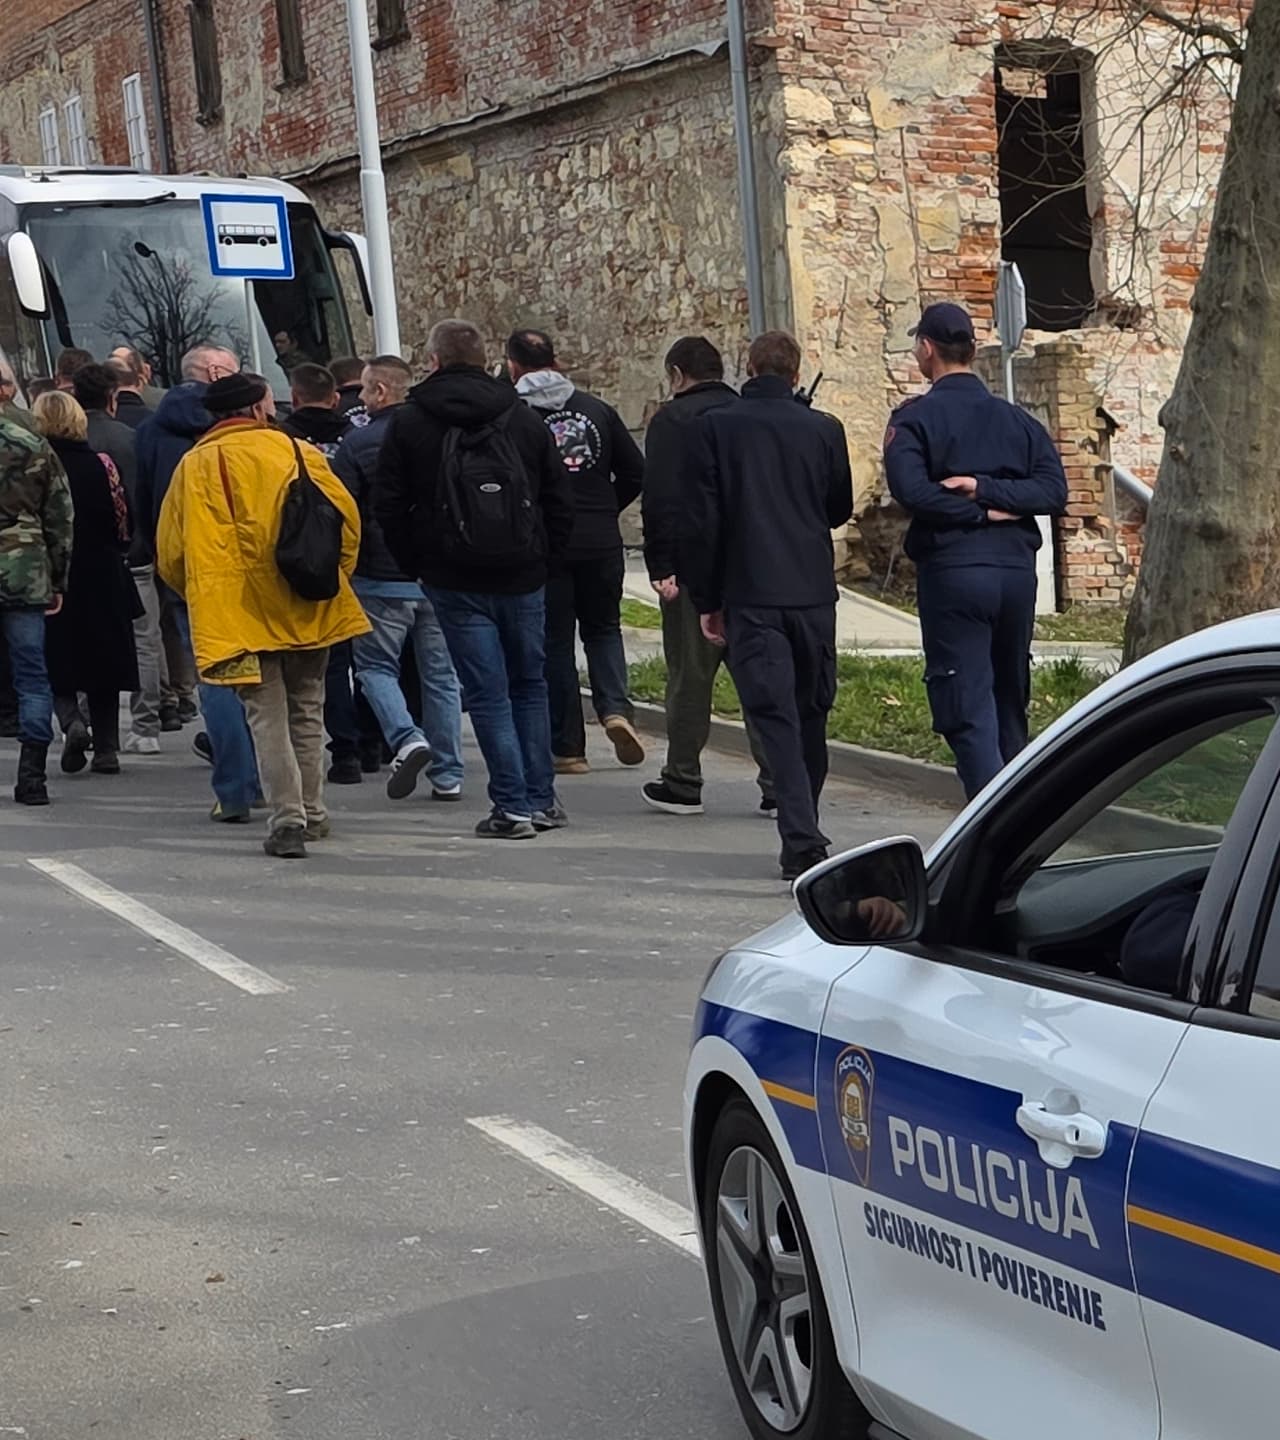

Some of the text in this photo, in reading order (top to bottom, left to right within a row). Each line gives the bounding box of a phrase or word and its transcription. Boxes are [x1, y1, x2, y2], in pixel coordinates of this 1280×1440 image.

[838, 1055, 872, 1088] POLICIJA
[888, 1115, 1100, 1250] POLICIJA
[863, 1201, 1107, 1332] SIGURNOST I POVJERENJE
